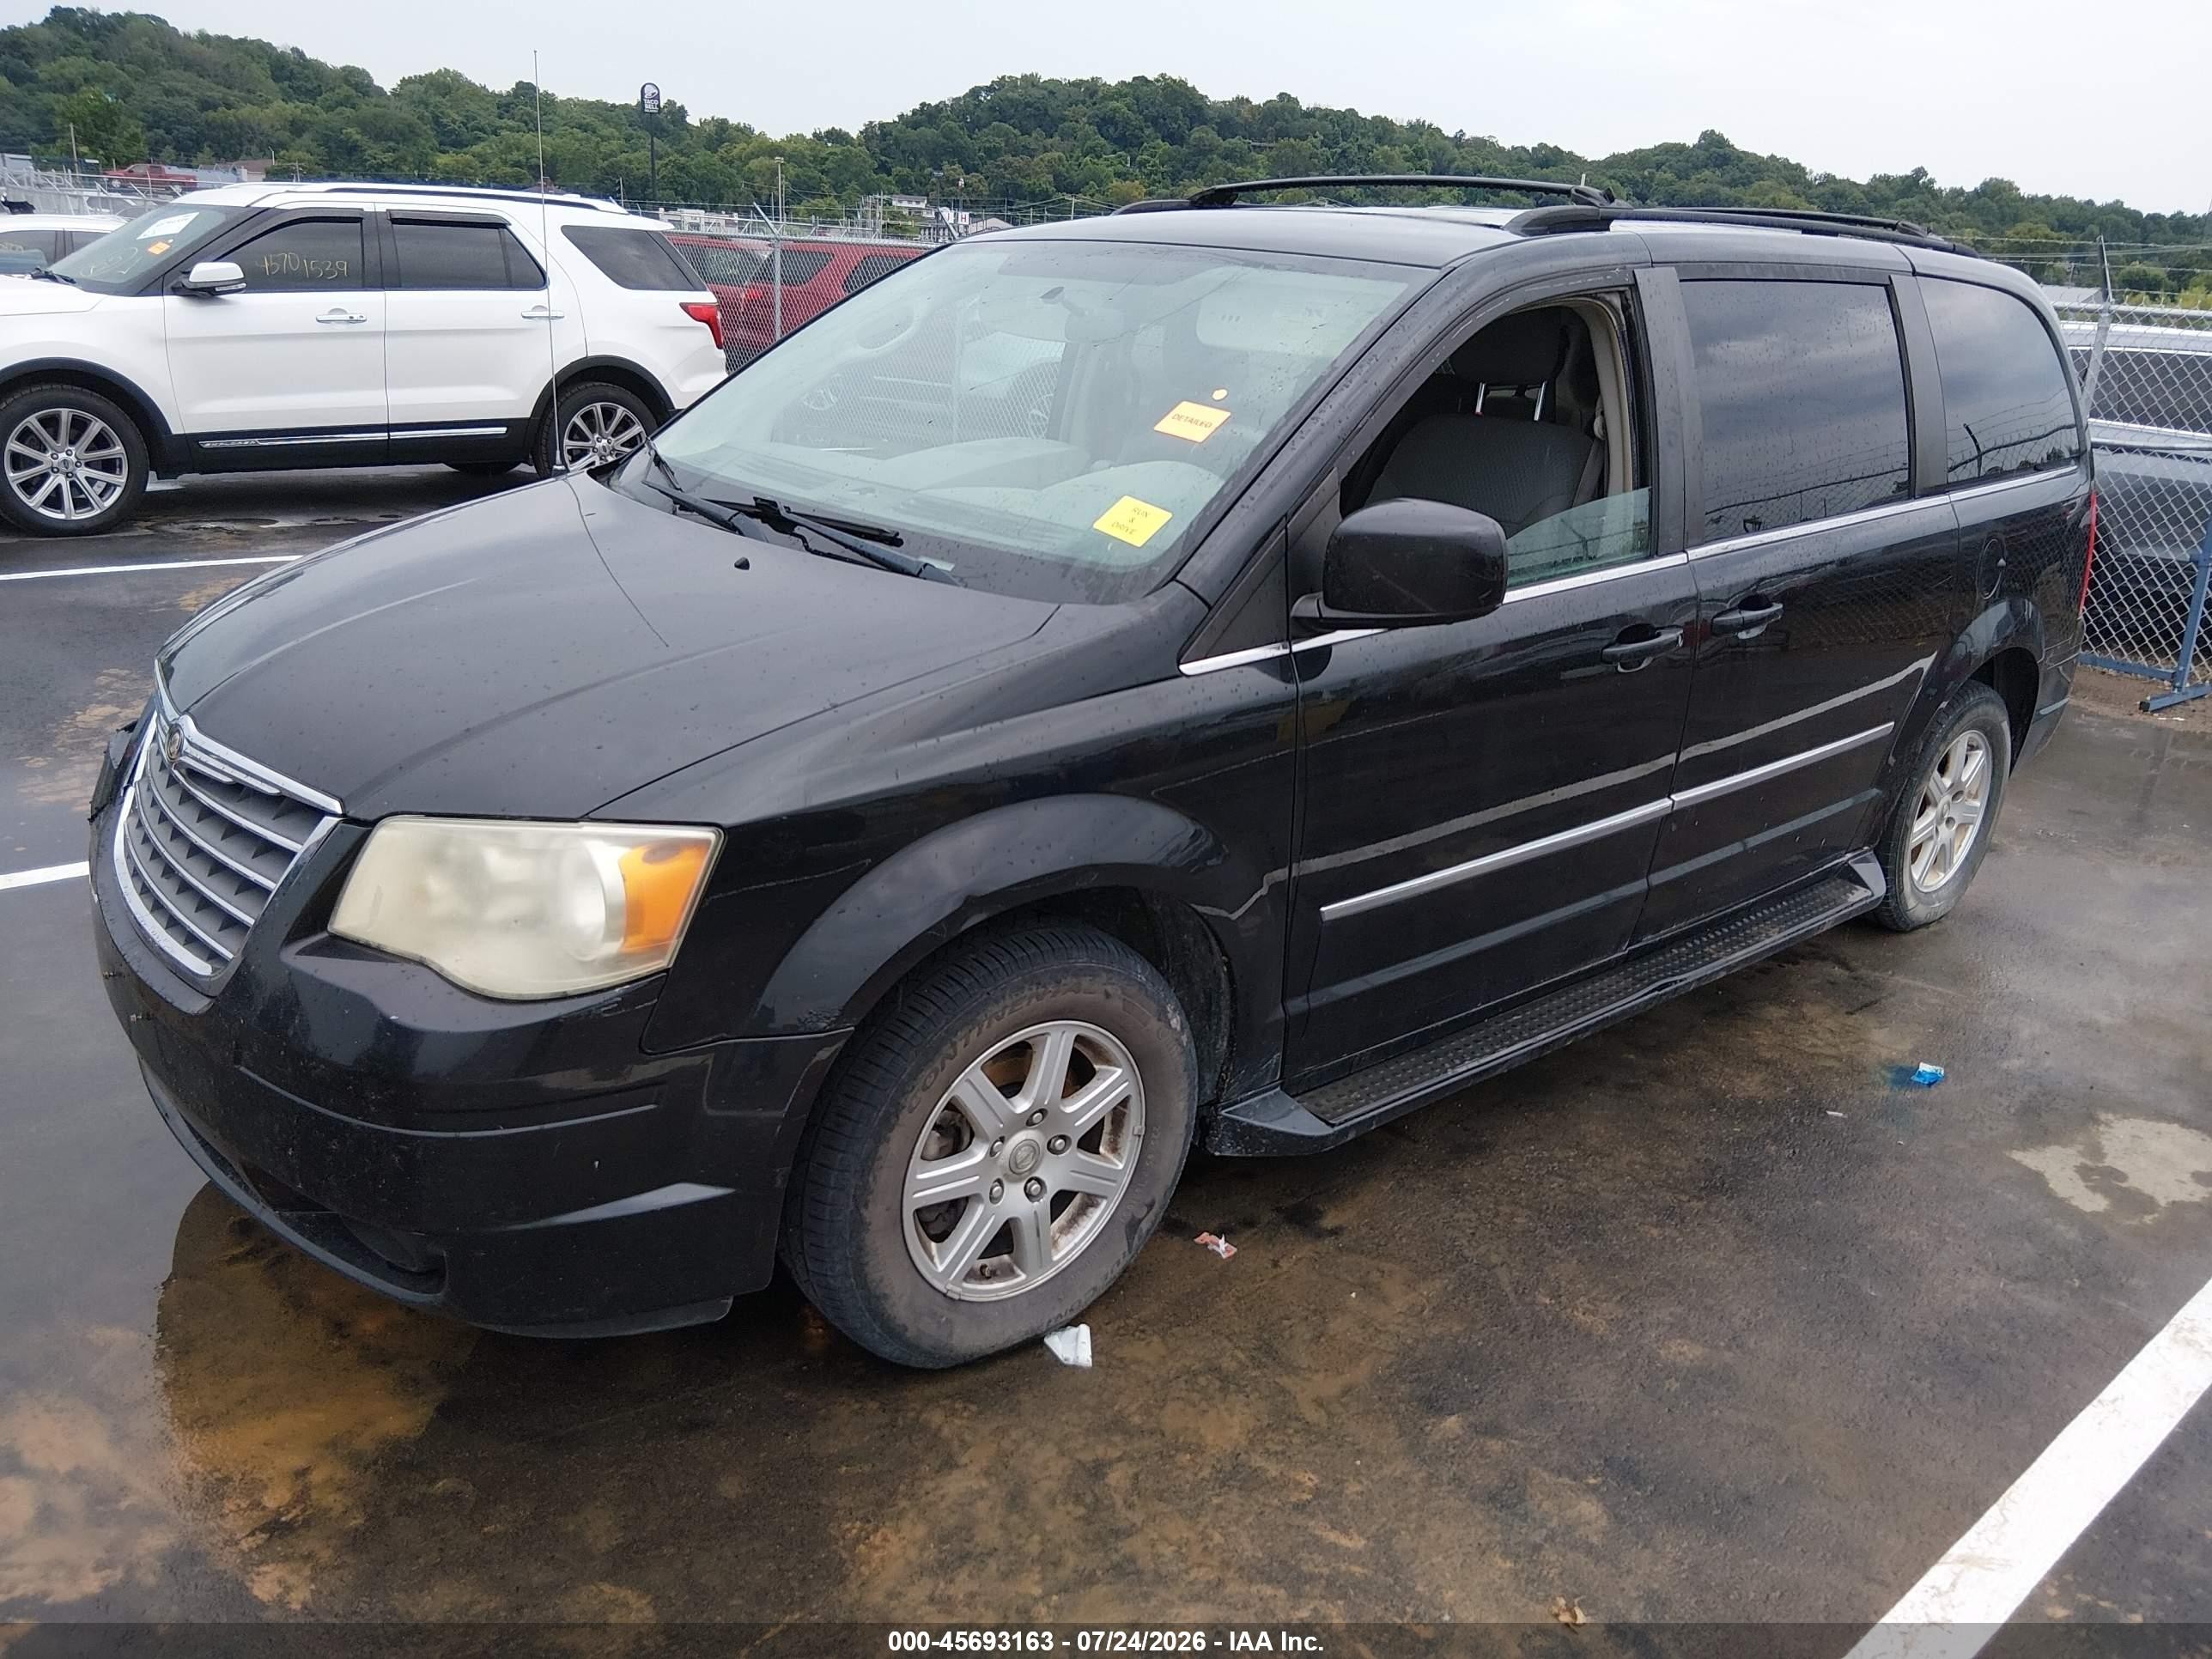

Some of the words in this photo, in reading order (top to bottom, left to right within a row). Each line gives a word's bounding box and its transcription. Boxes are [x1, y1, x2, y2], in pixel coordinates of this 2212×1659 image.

[1172, 413, 1213, 428] DETAILED
[1132, 507, 1150, 519] RUN
[1111, 520, 1138, 535] DRIVE
